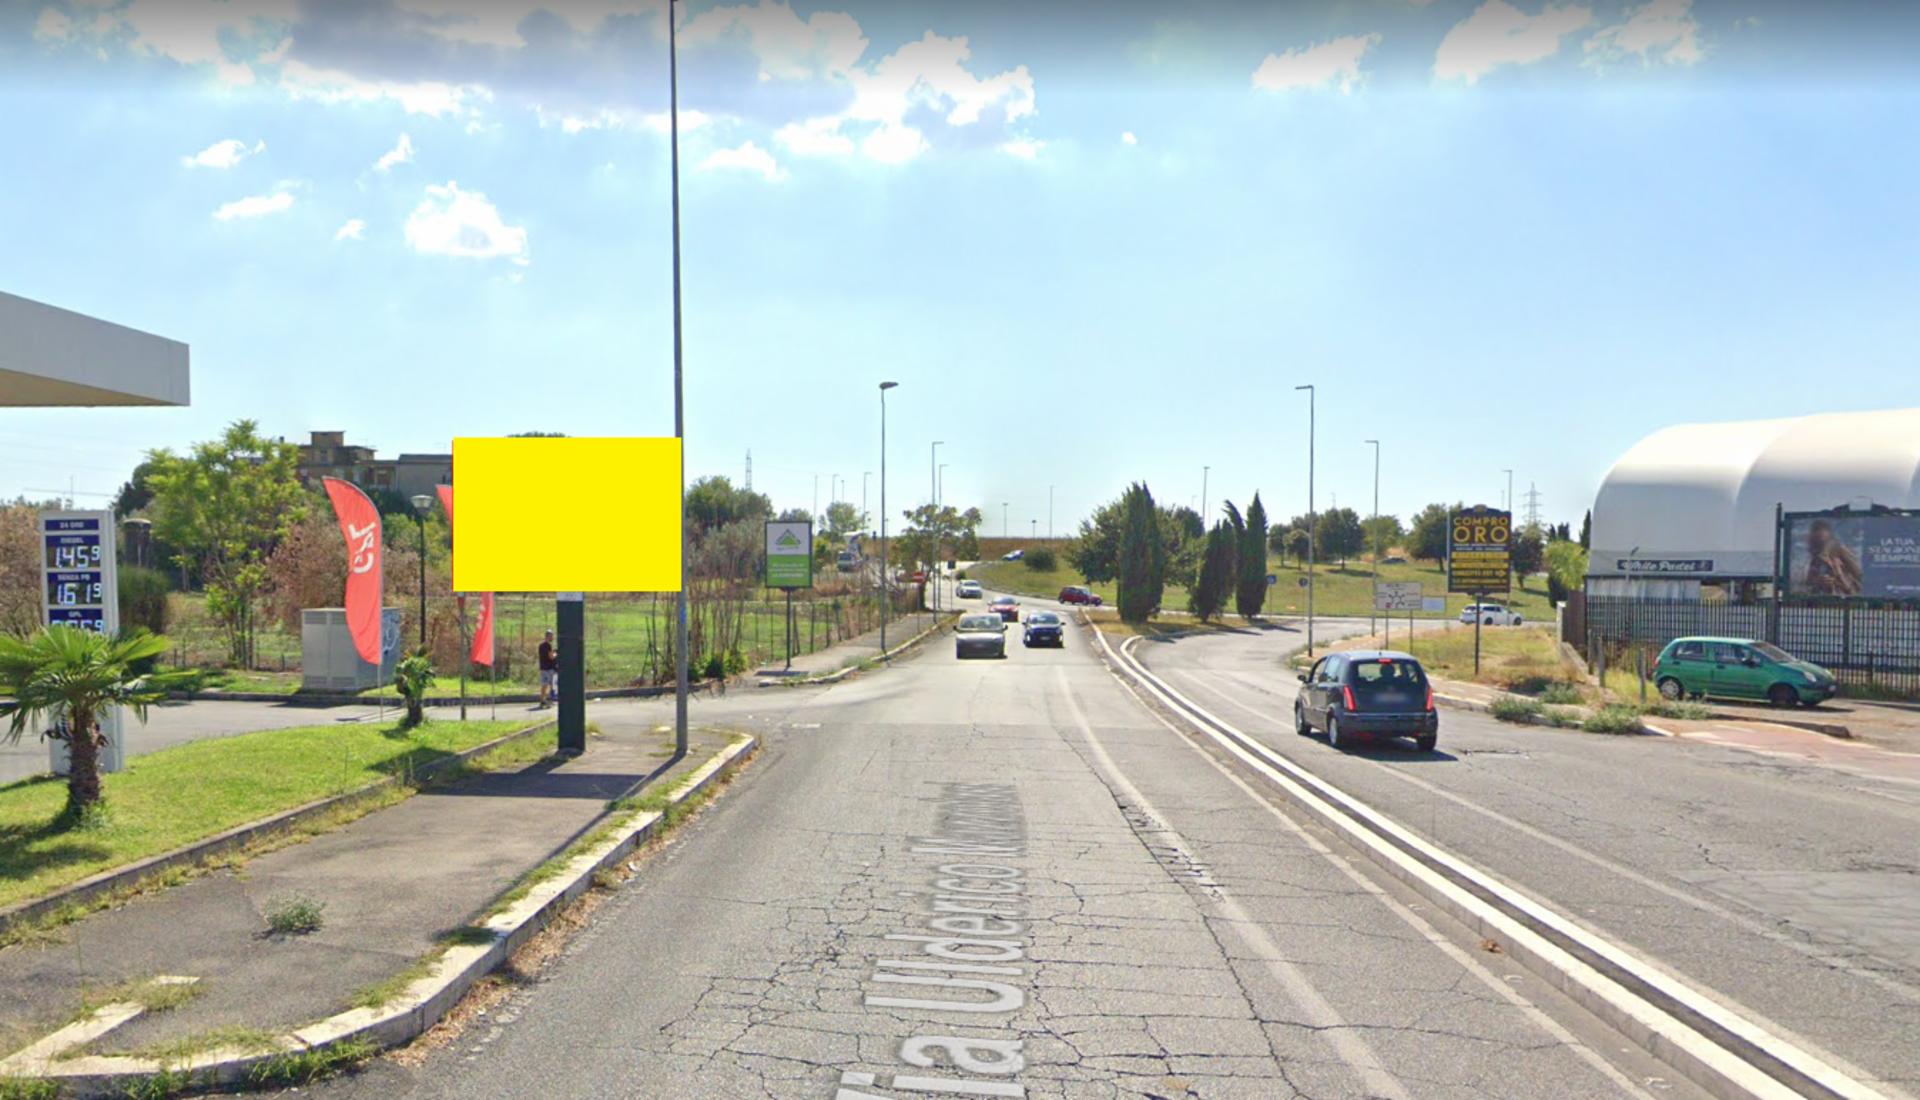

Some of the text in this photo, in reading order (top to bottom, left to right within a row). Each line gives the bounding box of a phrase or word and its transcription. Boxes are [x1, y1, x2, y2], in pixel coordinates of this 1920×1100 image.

[1453, 517, 1508, 526] COMPRO
[1453, 526, 1509, 543] ORO
[1880, 537, 1915, 546] LA TUA
